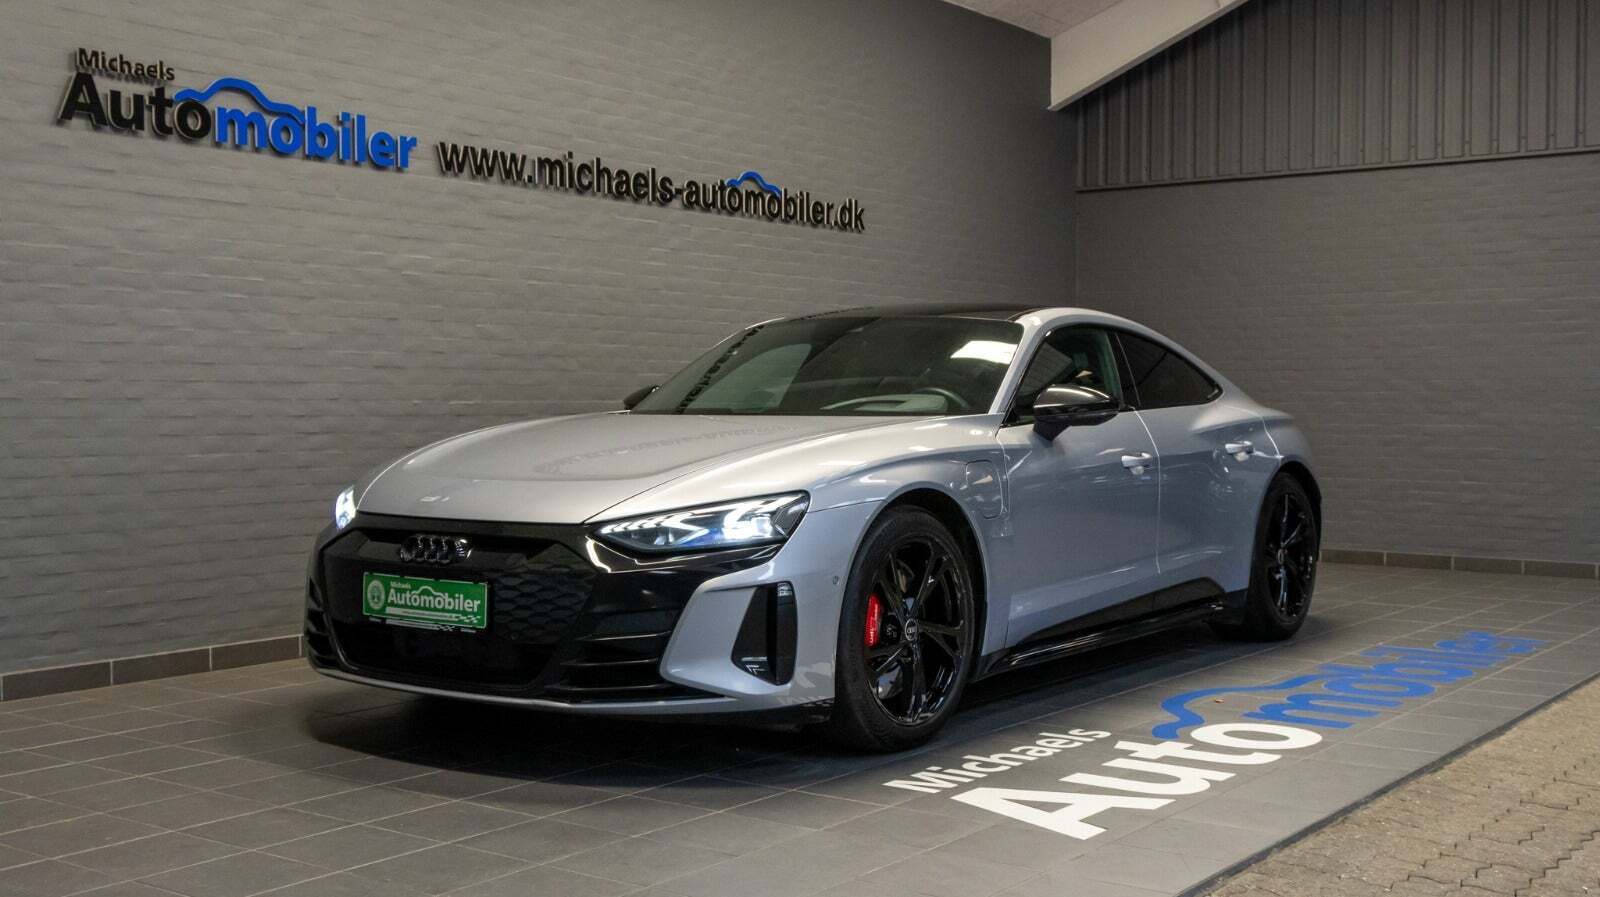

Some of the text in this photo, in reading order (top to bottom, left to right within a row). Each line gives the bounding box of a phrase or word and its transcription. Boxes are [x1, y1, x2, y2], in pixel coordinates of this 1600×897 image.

[78, 48, 176, 82] Michaels
[58, 71, 418, 169] Automobiler
[434, 140, 867, 233] www.michaels-automobiler.dk
[387, 588, 481, 612] Automobiler
[884, 724, 1112, 795] Michaels
[951, 630, 1548, 841] Automobiler
